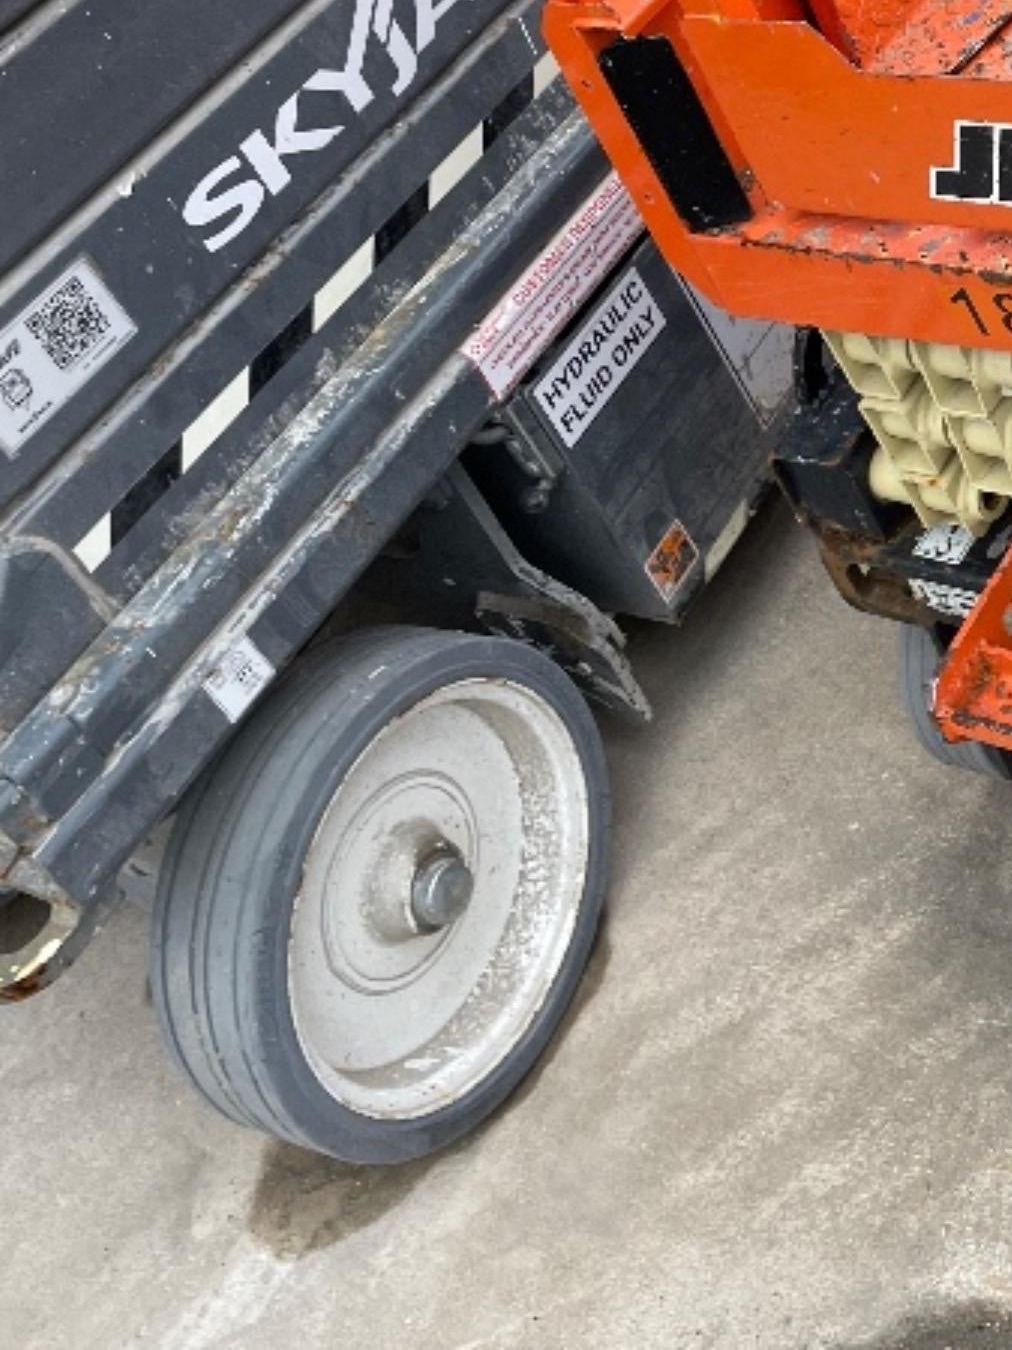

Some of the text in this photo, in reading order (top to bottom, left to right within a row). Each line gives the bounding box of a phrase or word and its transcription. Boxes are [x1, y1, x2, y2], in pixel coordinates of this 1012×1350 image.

[542, 279, 645, 410] HYDRAULIC
[560, 305, 656, 434] FLUID ONLY
